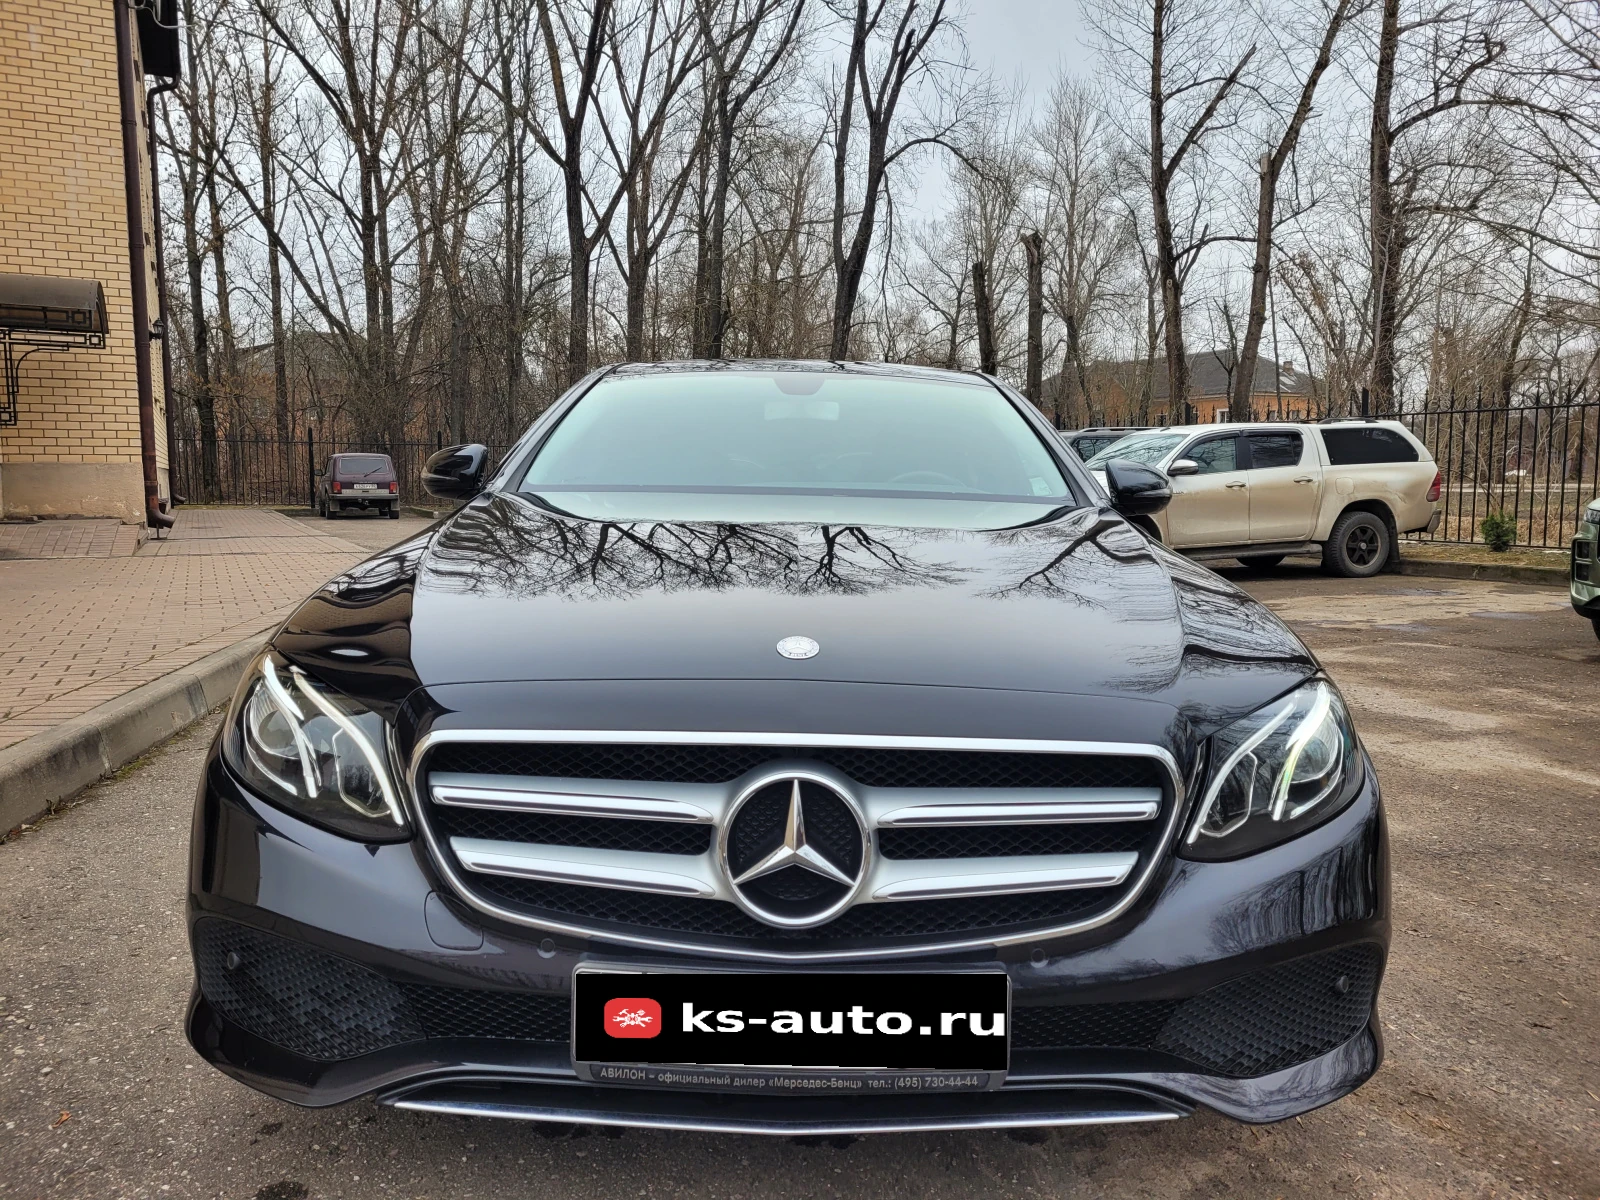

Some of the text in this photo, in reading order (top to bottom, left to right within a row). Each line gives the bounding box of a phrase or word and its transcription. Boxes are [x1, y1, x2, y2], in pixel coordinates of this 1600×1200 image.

[600, 1067, 646, 1080] АВИЛОН
[658, 1071, 731, 1084] официальный
[733, 1076, 766, 1088] дилер
[868, 1079, 892, 1088] тел.:
[894, 1077, 922, 1090] (495)
[925, 1075, 978, 1088] 730-44-44
